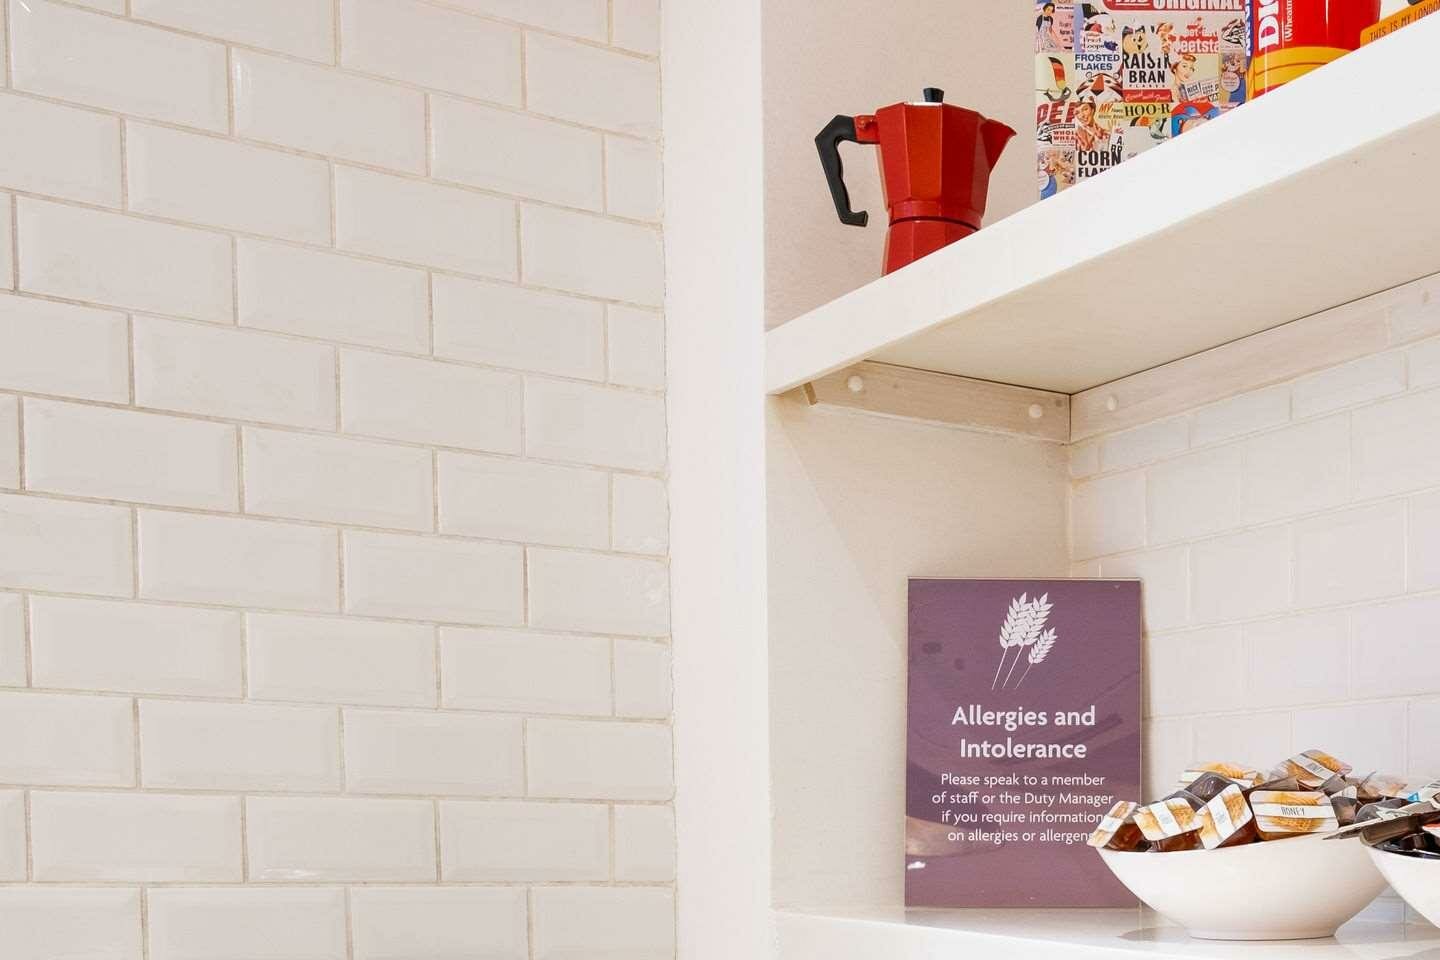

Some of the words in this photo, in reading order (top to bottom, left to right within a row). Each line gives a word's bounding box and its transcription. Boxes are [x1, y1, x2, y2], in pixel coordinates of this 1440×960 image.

[1258, 0, 1279, 51] DI
[1369, 27, 1386, 41] THIS
[1075, 54, 1120, 62] FROSTED
[1075, 63, 1113, 71] FLAKES
[1129, 70, 1165, 83] BRAN
[1078, 151, 1121, 166] CORN
[1078, 167, 1110, 177] FLA
[952, 705, 1047, 731] Allergies
[1054, 705, 1096, 726] and
[960, 738, 1087, 758] Intolerance
[941, 774, 980, 785] Please
[984, 774, 1019, 788] speak
[1024, 776, 1038, 785] to
[1041, 777, 1048, 785] a
[1052, 774, 1105, 785] member
[932, 792, 947, 804] of
[950, 792, 978, 804] staff
[982, 795, 996, 804] or
[1000, 793, 1020, 804] the
[1024, 793, 1056, 807] Duty
[1059, 794, 1114, 808] Manager
[942, 811, 950, 823] if
[954, 814, 978, 826] you
[982, 811, 1025, 826] require
[1029, 811, 1105, 823] information
[948, 832, 964, 841] on
[968, 829, 1018, 845] allergies
[1022, 832, 1036, 841] or
